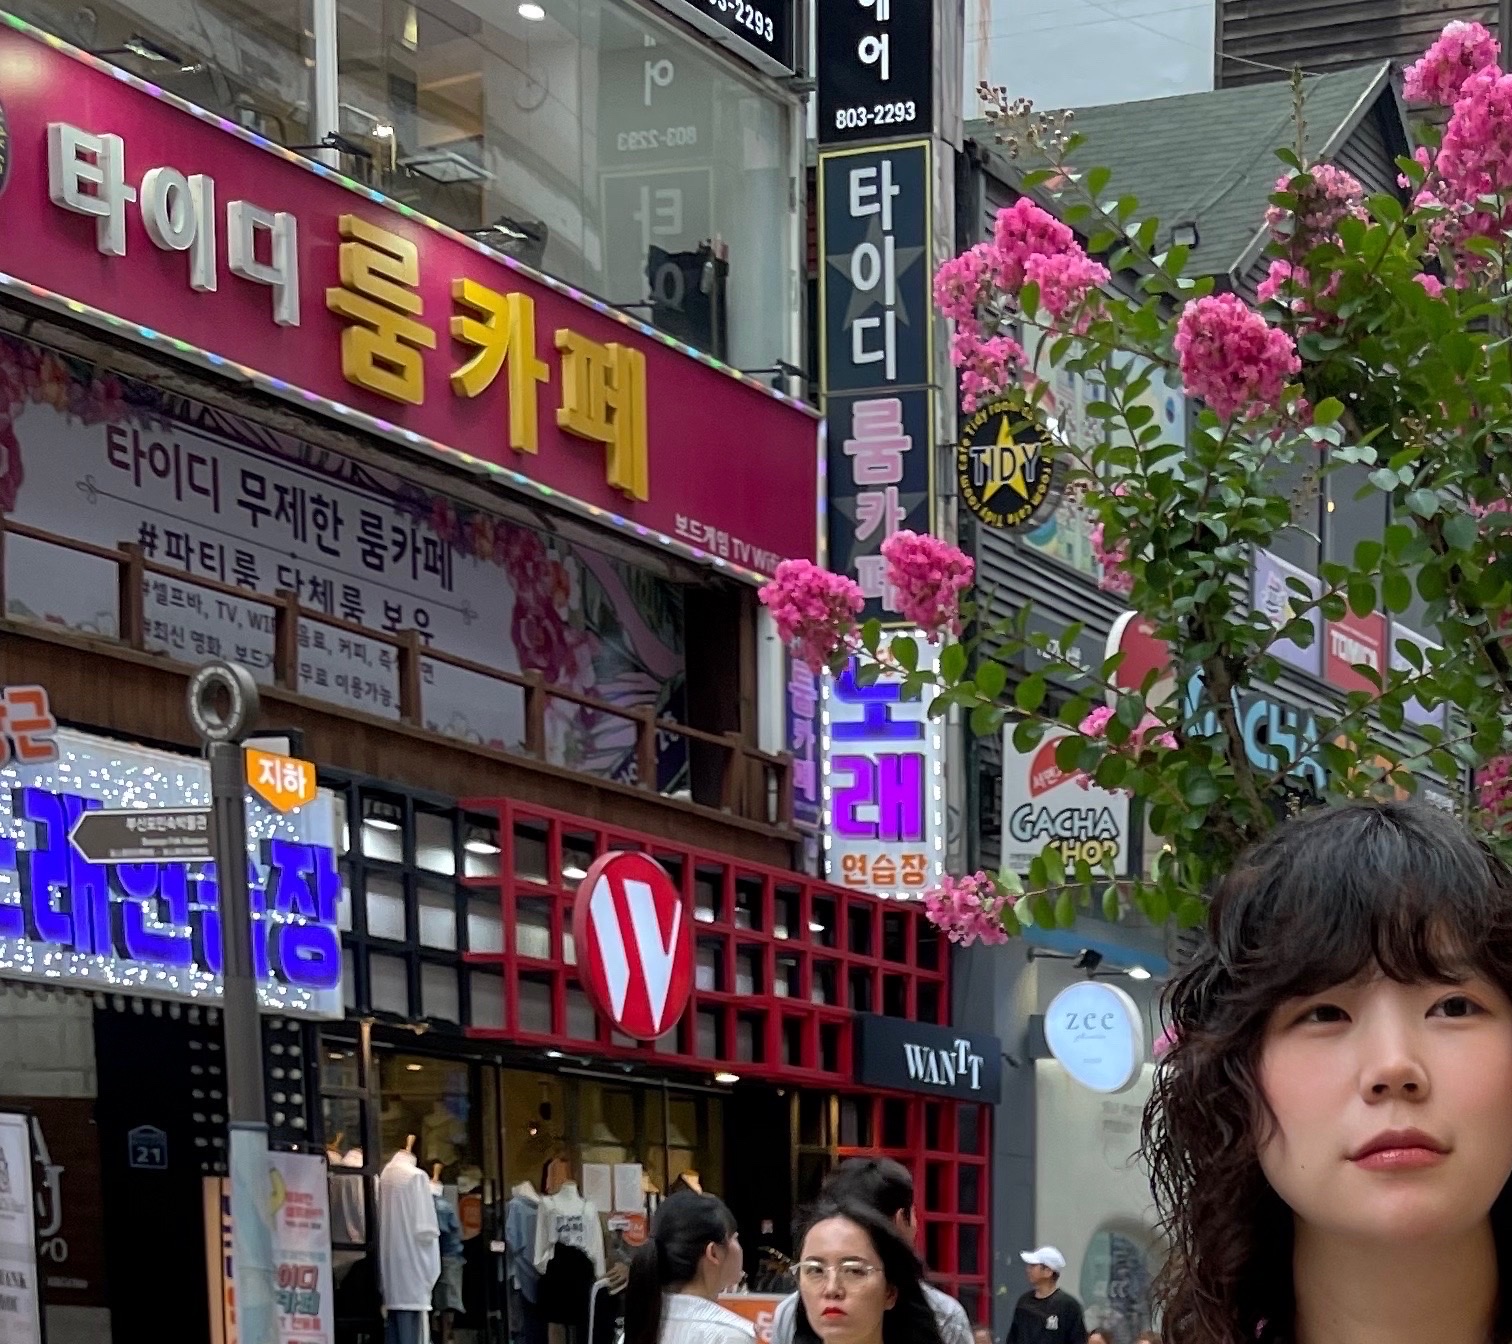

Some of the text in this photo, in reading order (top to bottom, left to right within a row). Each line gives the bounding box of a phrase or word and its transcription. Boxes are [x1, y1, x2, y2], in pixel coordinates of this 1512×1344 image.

[857, 0, 892, 81] 어
[835, 101, 916, 130] 803-2293
[848, 160, 900, 381] 타이디
[48, 121, 649, 502] 타이디 룸카페
[968, 442, 1042, 487] TIDY
[106, 424, 454, 592] 타이디 무제한 룸카페
[731, 536, 751, 563] TV
[831, 654, 927, 842] 노래
[258, 757, 307, 799] 지하
[1009, 803, 1120, 843] GACHA
[840, 852, 930, 887] 연습장
[1065, 1012, 1115, 1030] zee
[903, 1038, 985, 1091] WANTT
[135, 1146, 162, 1164] 21
